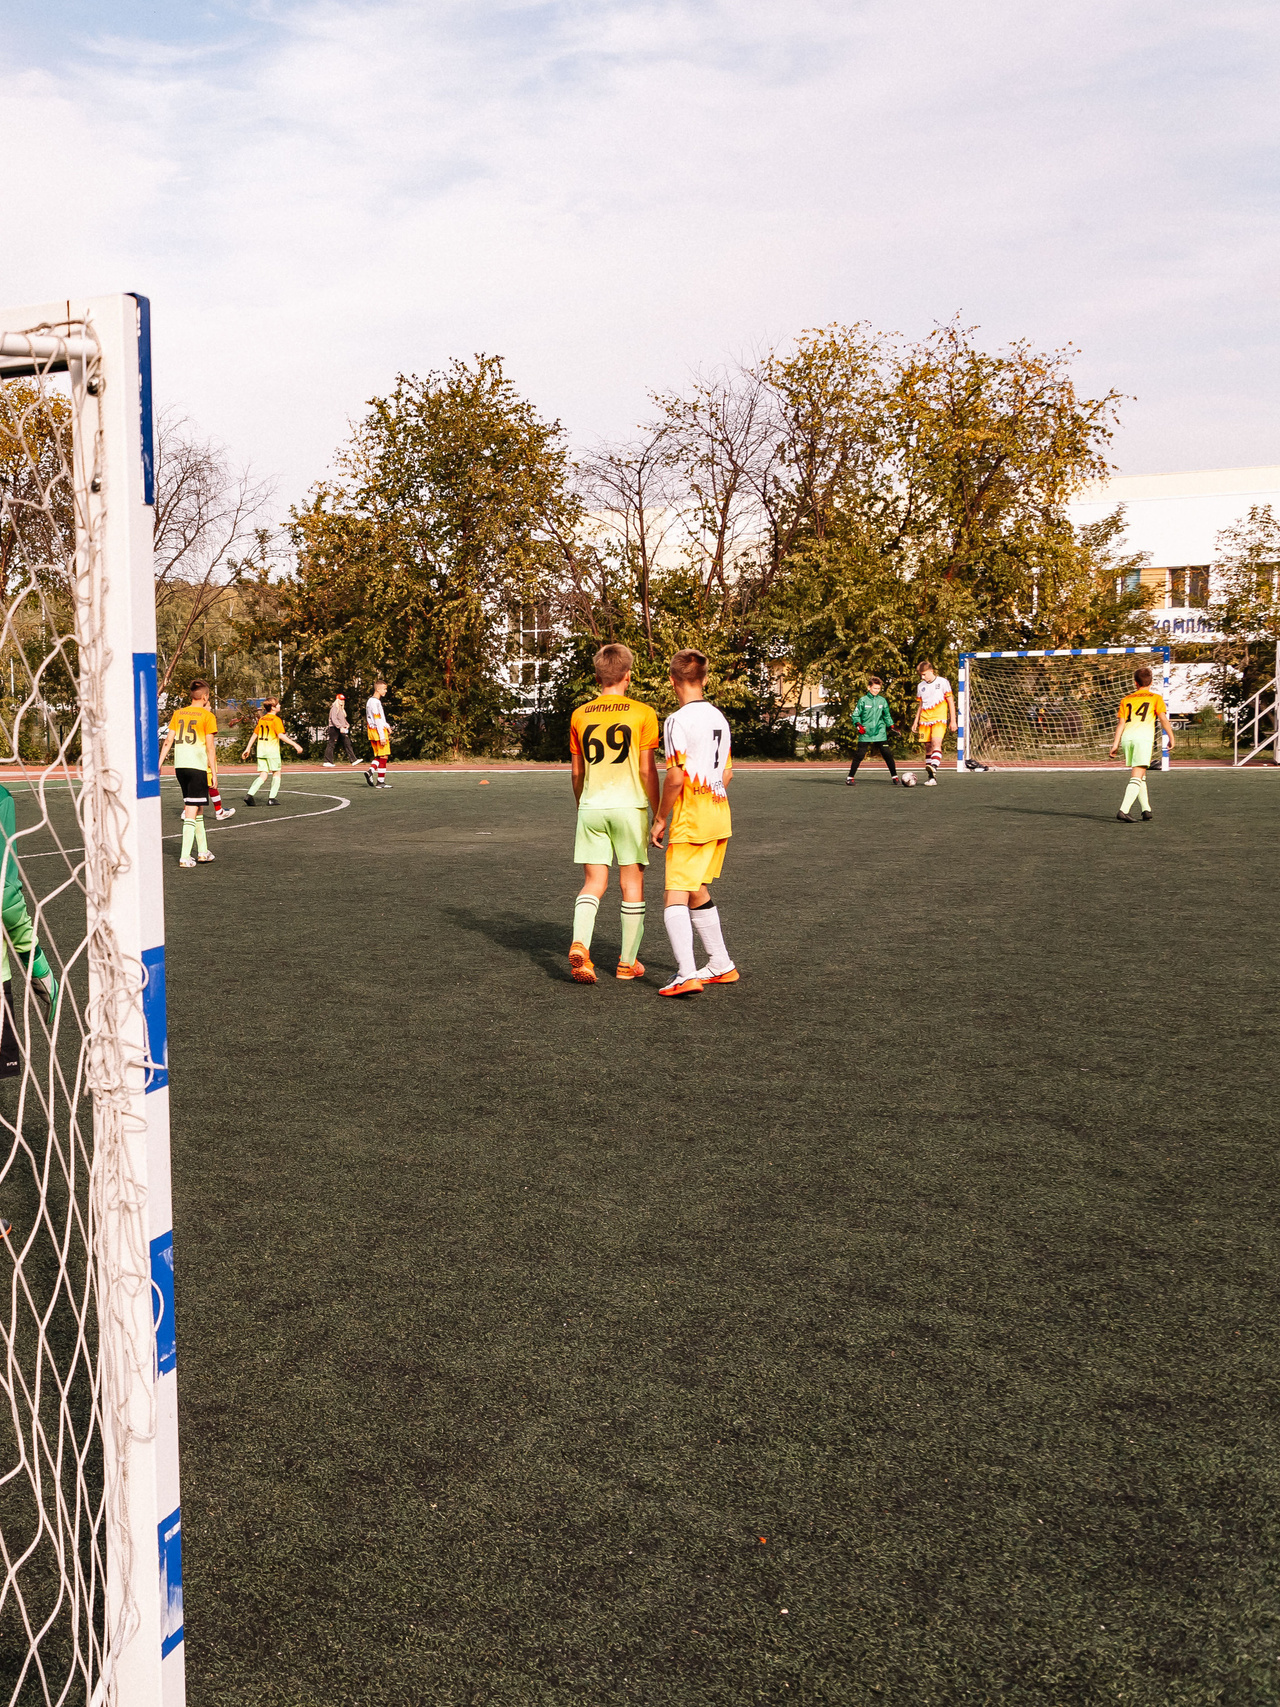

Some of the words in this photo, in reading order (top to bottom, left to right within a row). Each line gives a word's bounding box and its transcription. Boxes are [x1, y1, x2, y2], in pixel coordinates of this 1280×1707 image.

[584, 703, 631, 714] ШИПИЛОВ
[1125, 702, 1150, 723] 14
[175, 719, 198, 745] 15
[259, 724, 270, 741] 11
[582, 722, 632, 766] 69
[713, 729, 723, 769] 7
